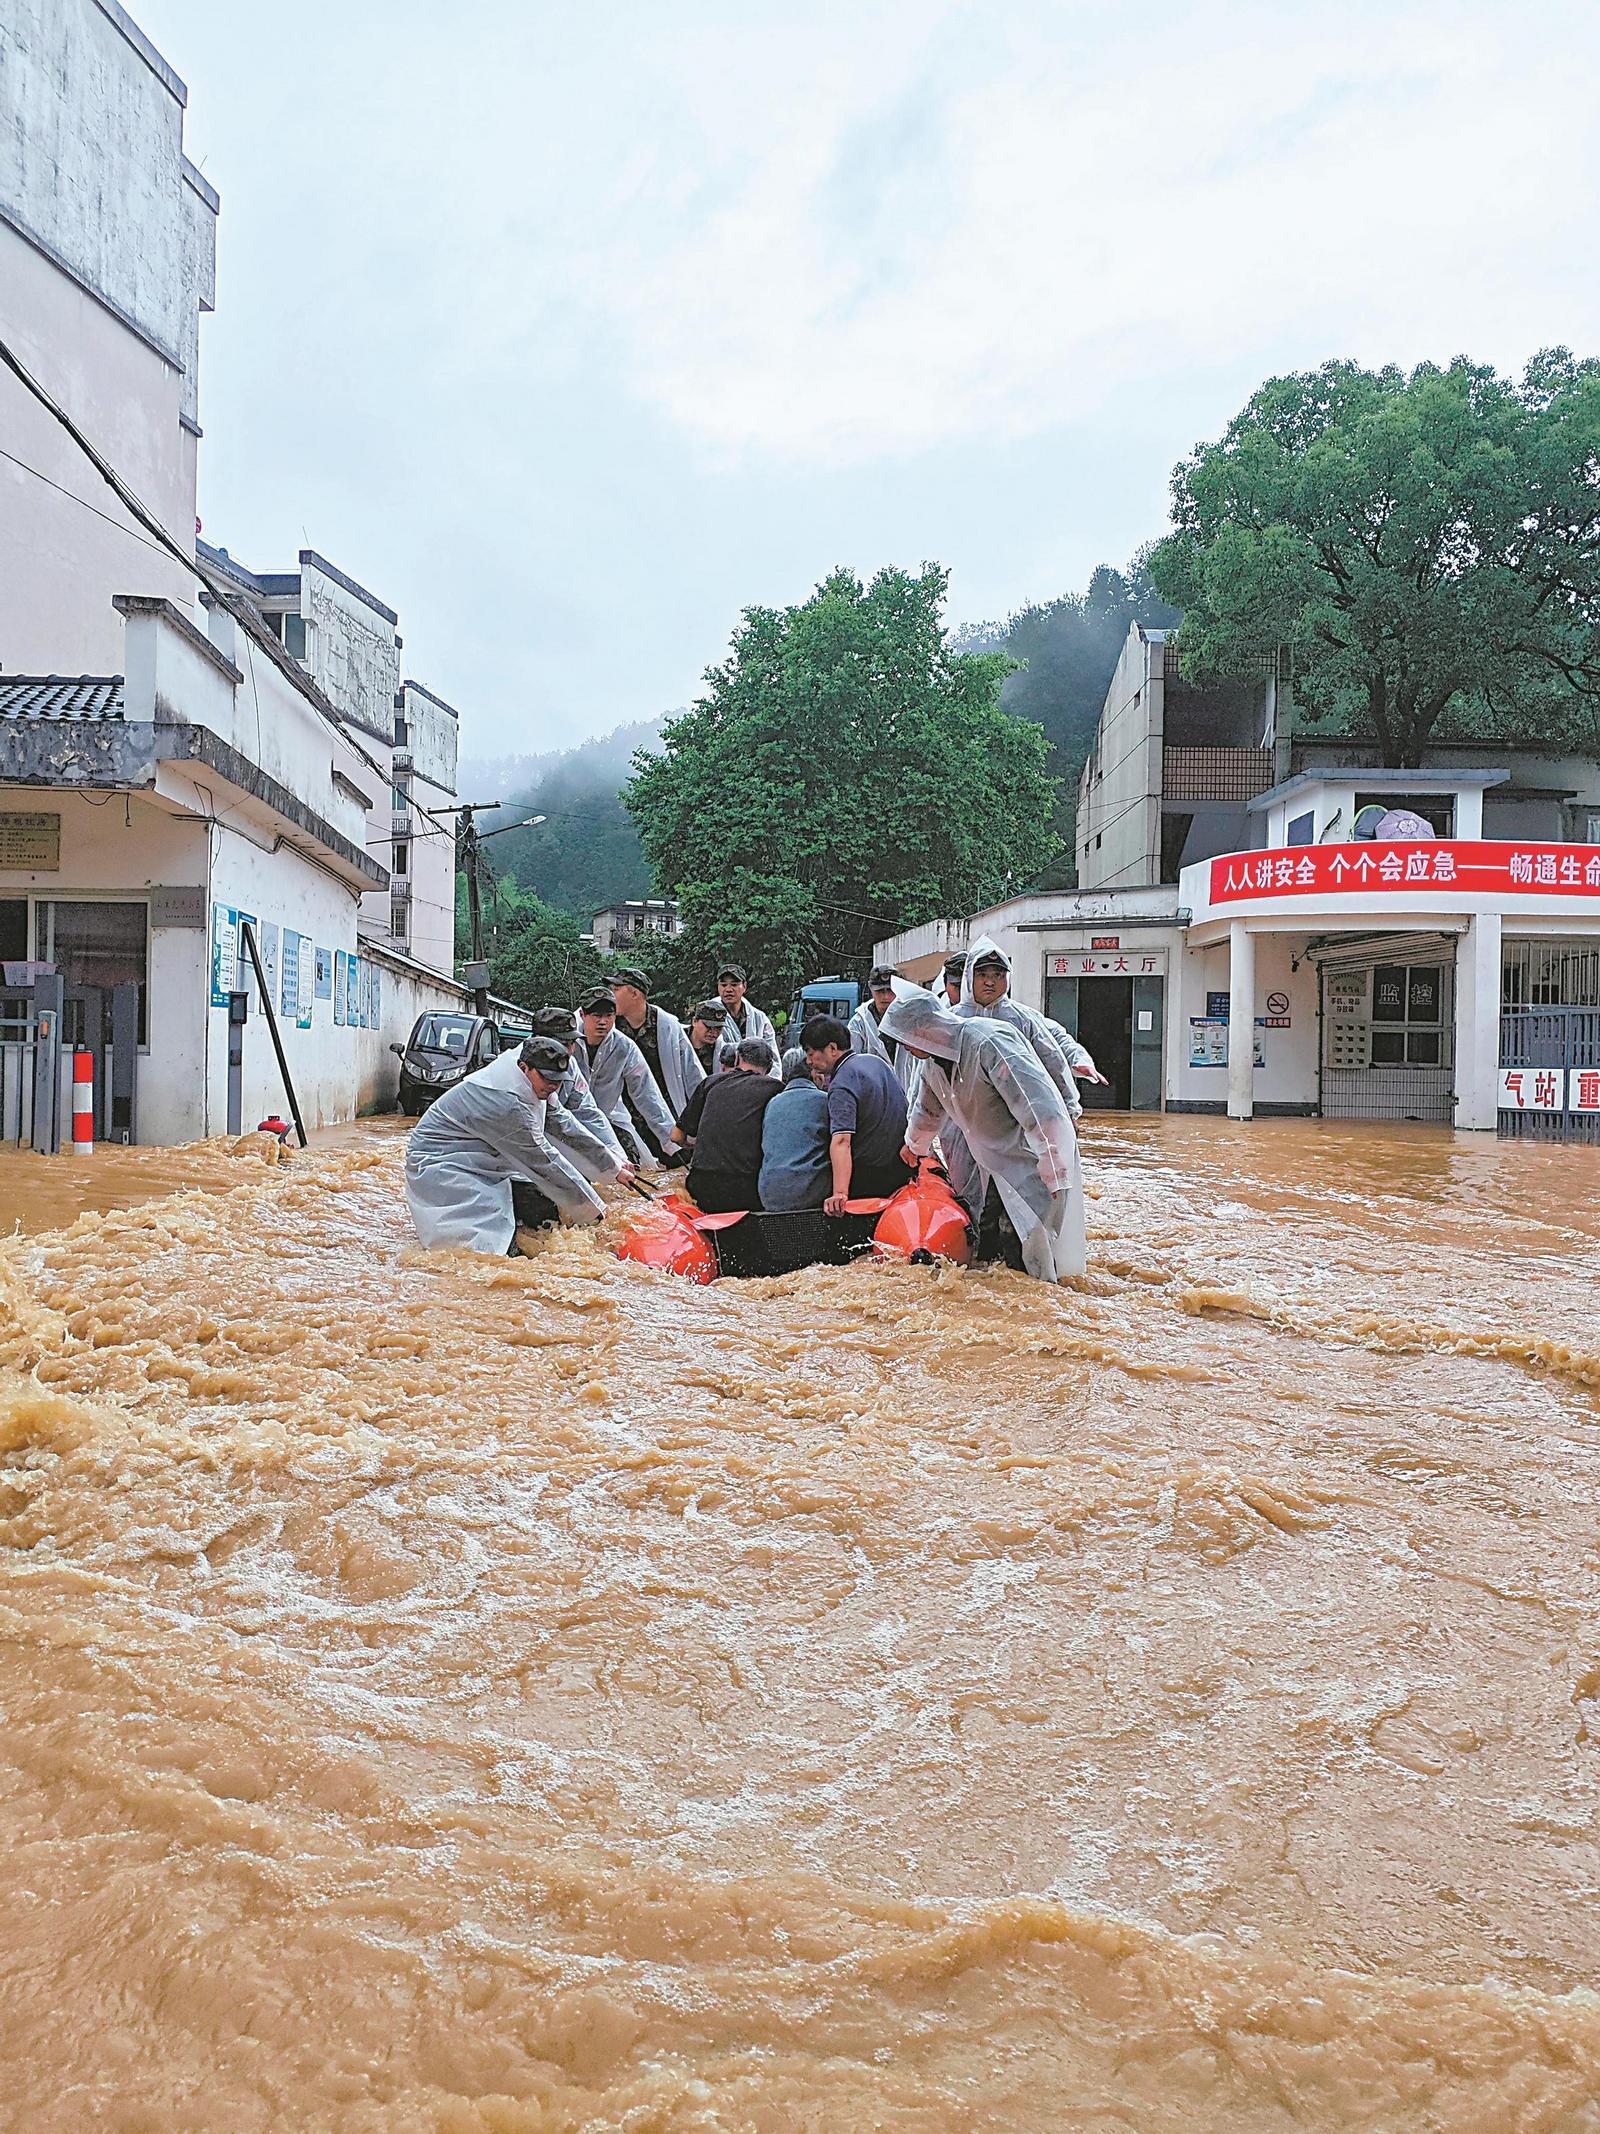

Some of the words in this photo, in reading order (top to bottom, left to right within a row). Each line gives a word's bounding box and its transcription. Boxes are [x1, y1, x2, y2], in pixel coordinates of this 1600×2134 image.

[1223, 856, 1316, 893] 人人讲安全
[1054, 957, 1157, 974] 营业大厅
[1379, 983, 1433, 1006] 监控
[1504, 1071, 1557, 1108] 气站
[1577, 1071, 1600, 1109] 重
